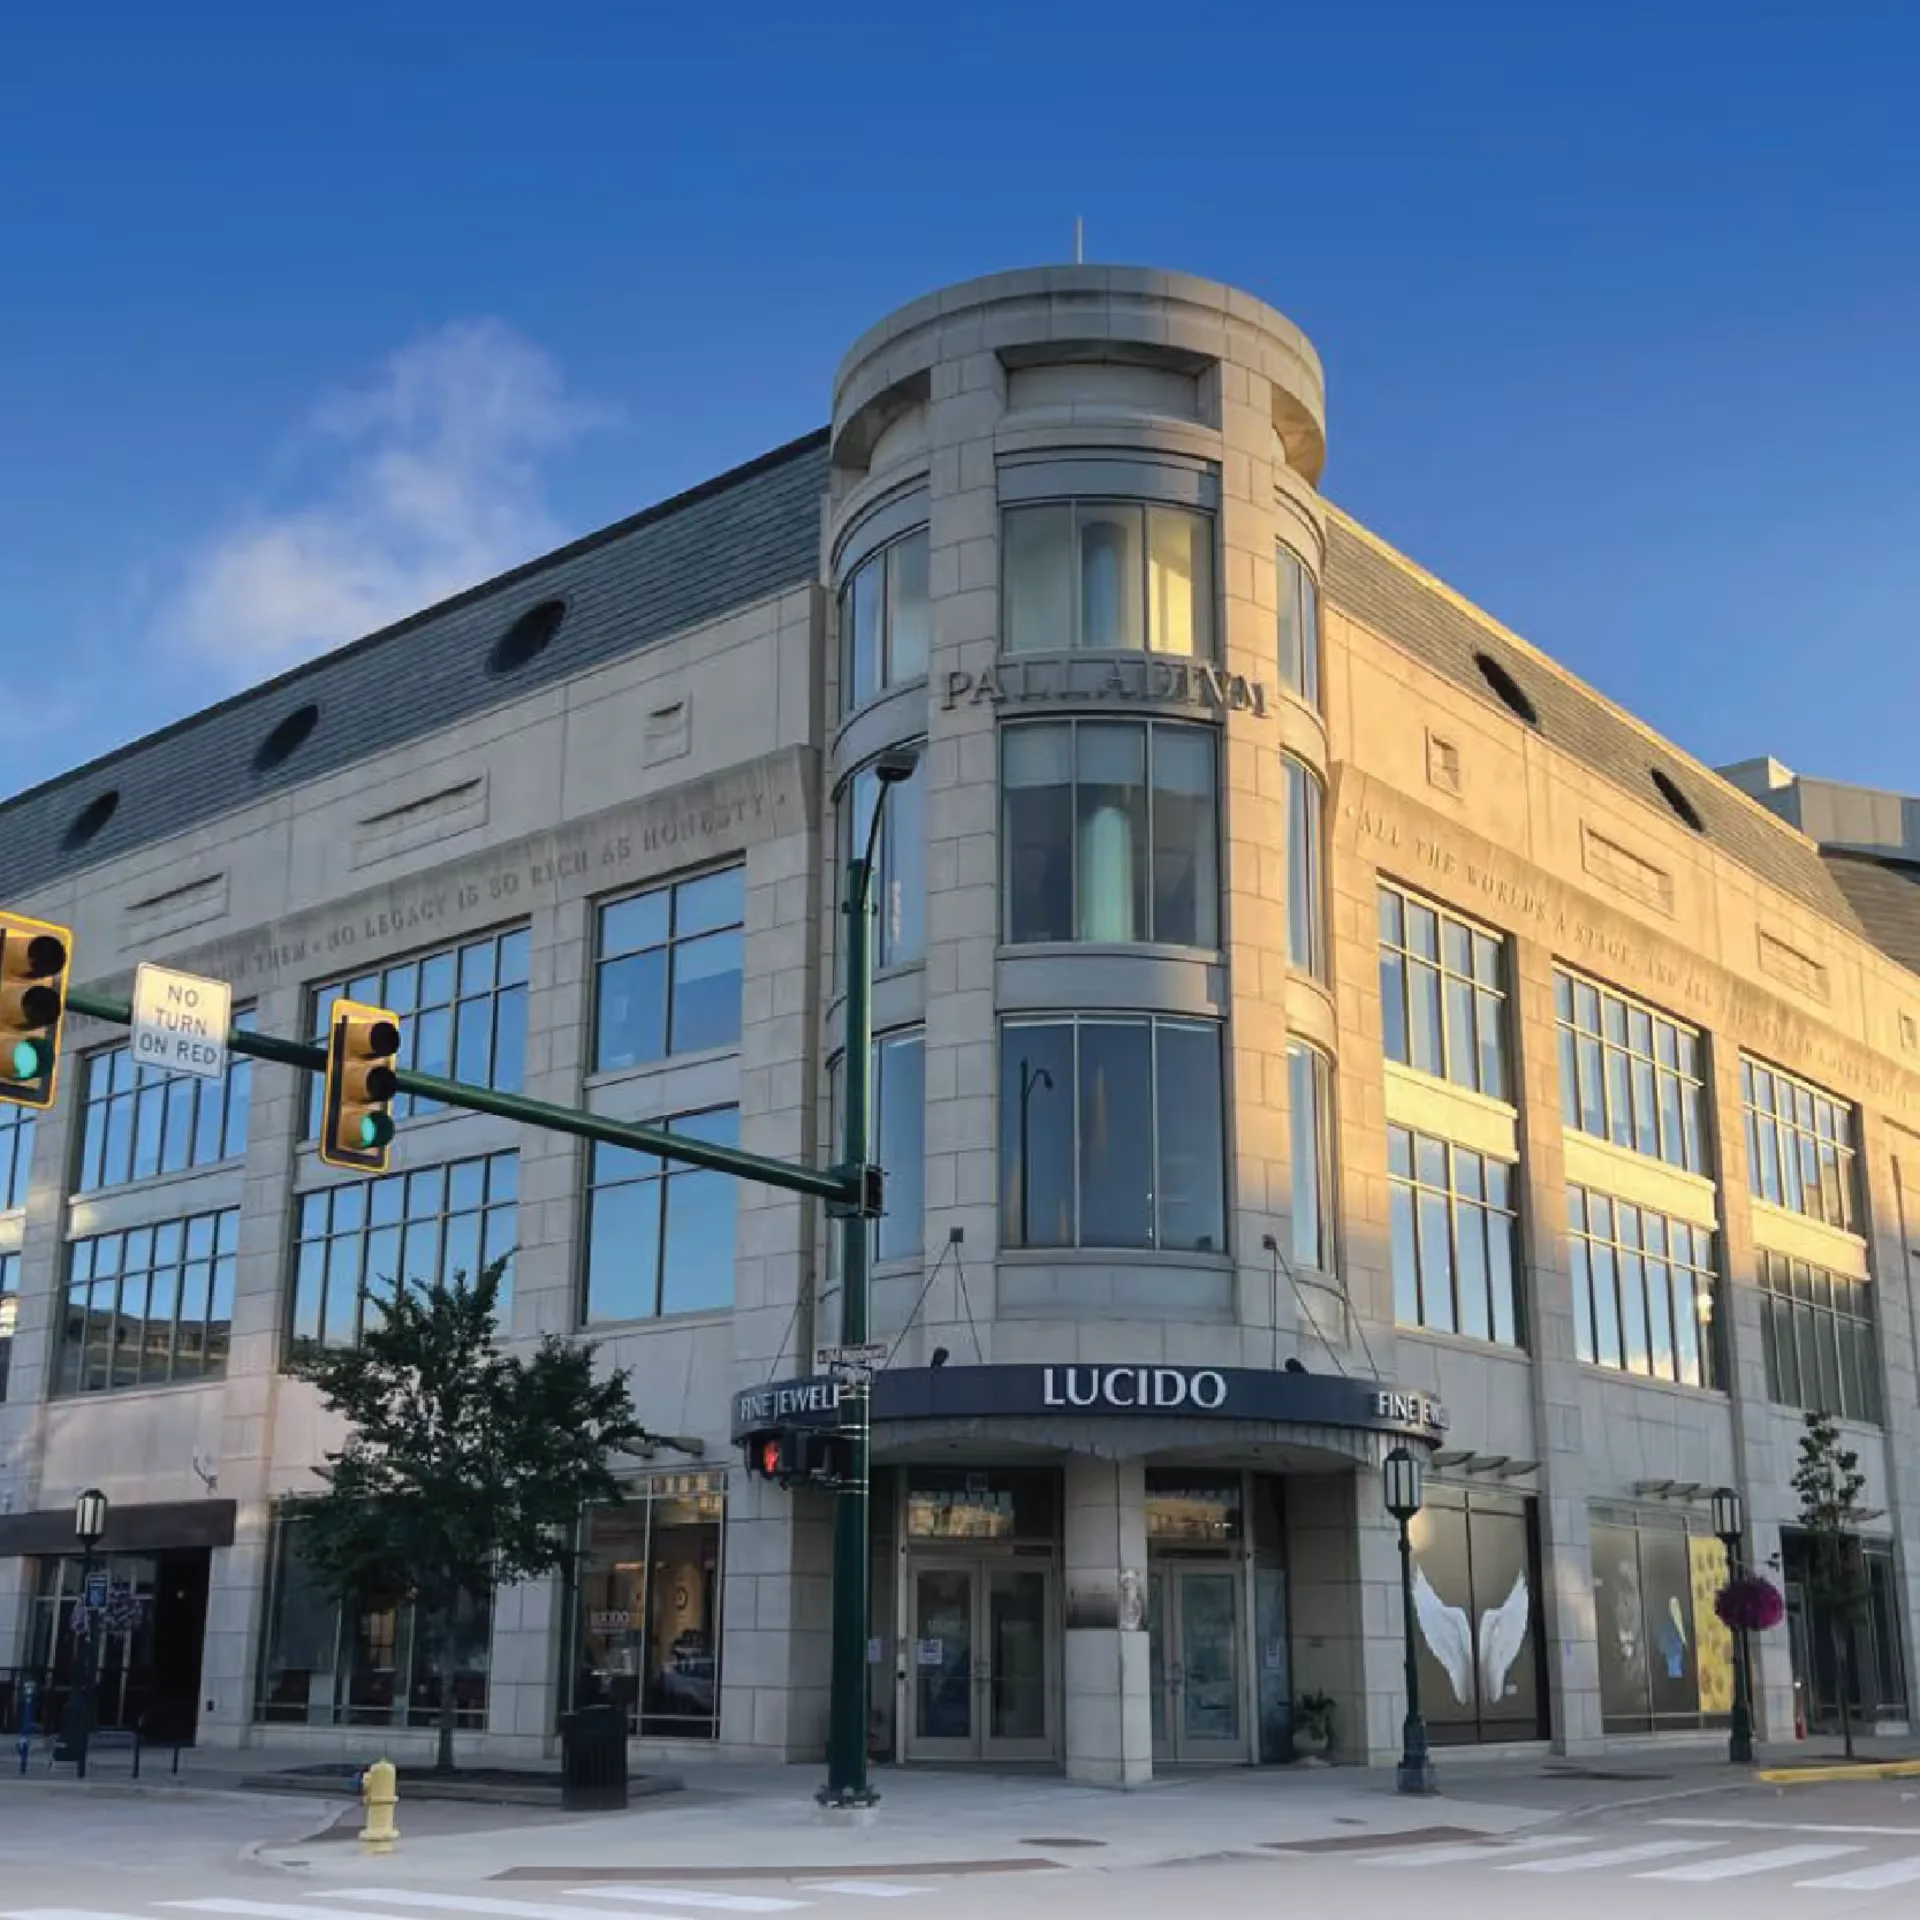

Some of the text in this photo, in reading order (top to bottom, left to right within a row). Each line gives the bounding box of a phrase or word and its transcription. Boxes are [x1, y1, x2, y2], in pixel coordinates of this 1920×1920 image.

[1360, 809, 1400, 847] ALL
[1416, 836, 1457, 874] THE
[365, 895, 446, 938] LEGACY
[532, 849, 590, 886] RICH
[602, 836, 631, 867] AS
[167, 984, 199, 1009] NO
[155, 1008, 208, 1037] TURN
[138, 1033, 218, 1065] ON RED
[1043, 1367, 1227, 1409] LUCIDO
[1379, 1390, 1418, 1423] FINE
